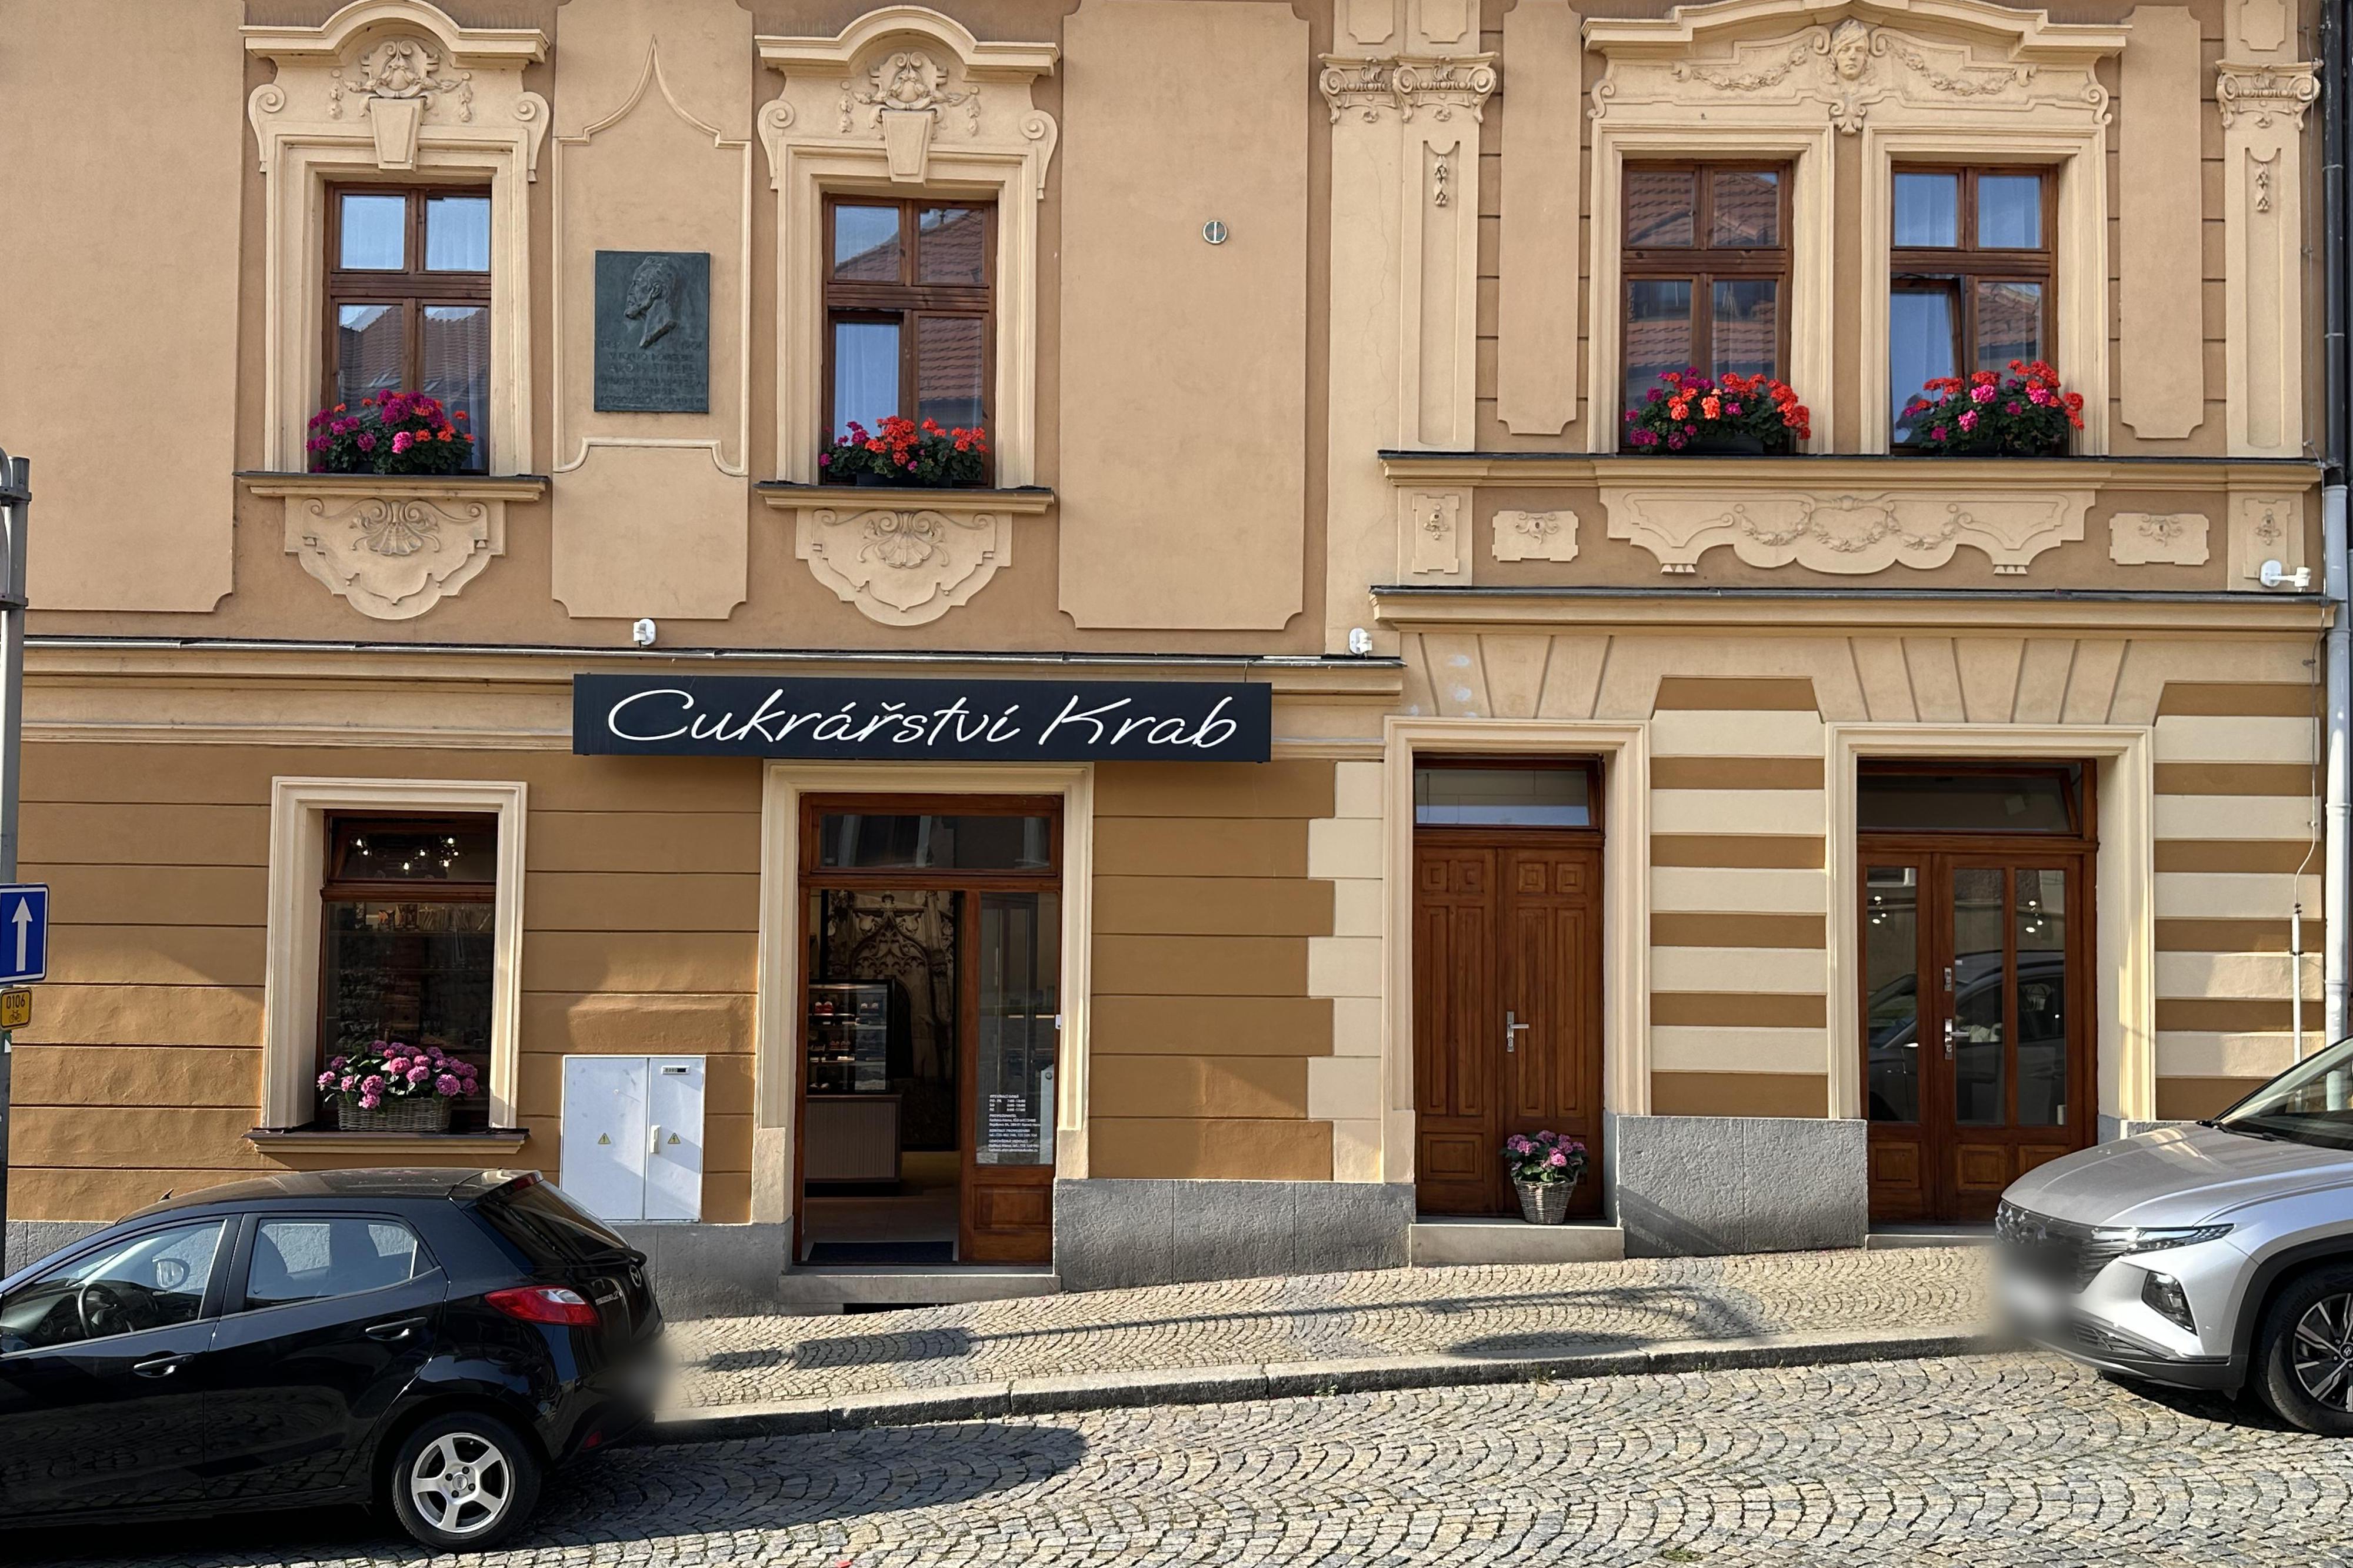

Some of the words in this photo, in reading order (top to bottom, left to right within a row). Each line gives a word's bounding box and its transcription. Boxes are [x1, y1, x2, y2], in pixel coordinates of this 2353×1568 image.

[608, 689, 1022, 746] Cukrářství
[1038, 695, 1237, 749] Krab
[6, 994, 25, 1009] 0106
